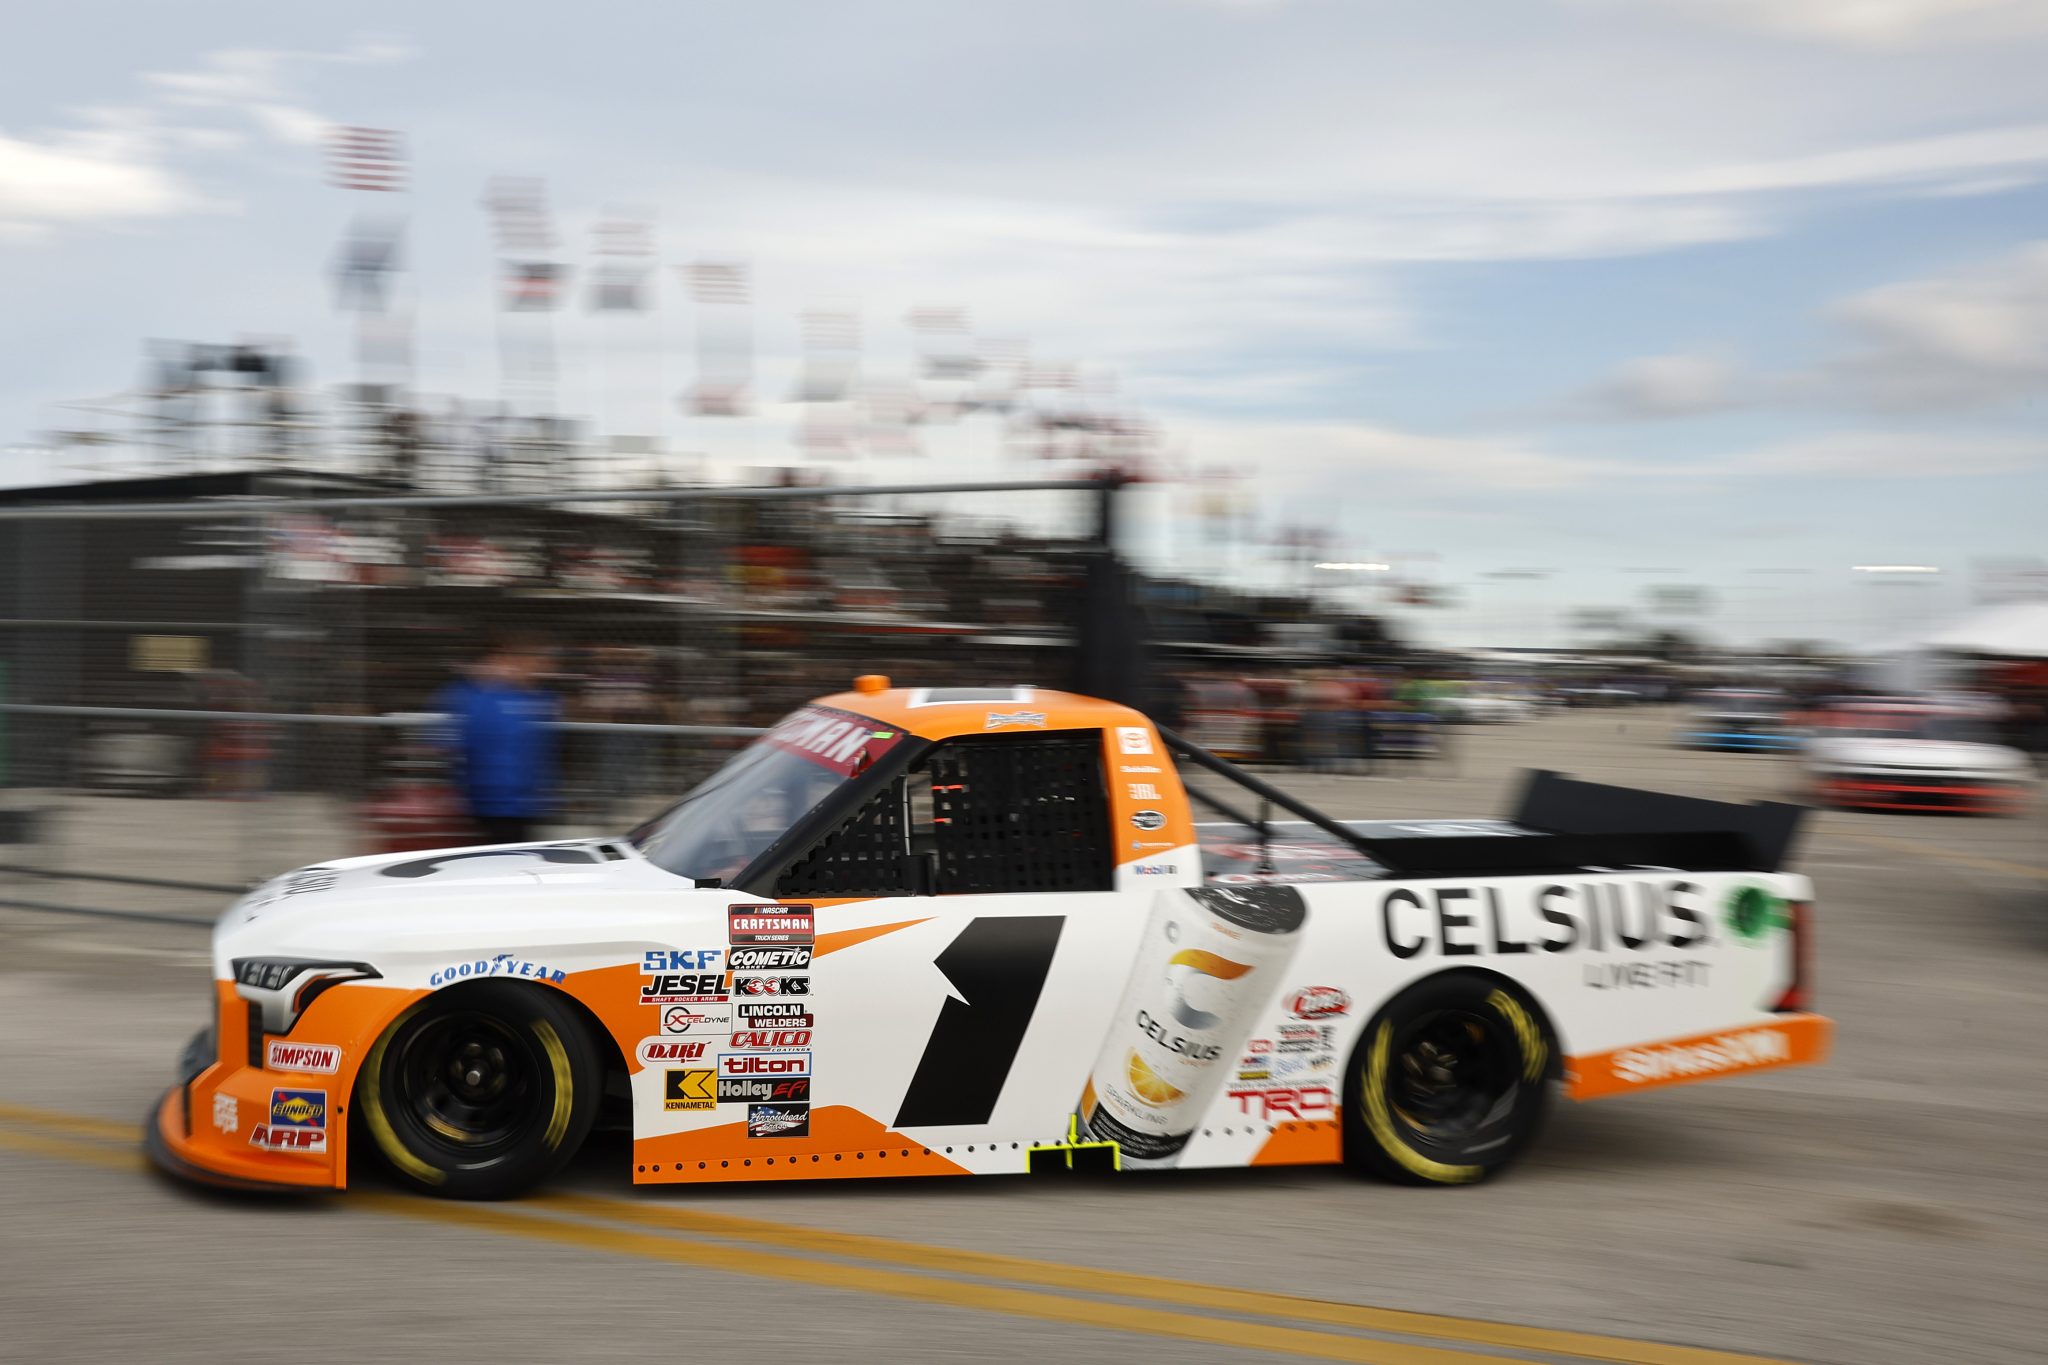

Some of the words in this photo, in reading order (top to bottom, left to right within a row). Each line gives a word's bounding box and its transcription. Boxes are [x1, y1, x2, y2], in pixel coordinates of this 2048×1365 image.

[733, 918, 809, 930] CRAFTSMAN
[1383, 880, 1710, 959] CELSIUS
[644, 951, 721, 970] SKF
[730, 951, 811, 966] COMETIC
[430, 957, 567, 986] GOODYEAR
[643, 975, 730, 995] JESEL
[734, 976, 810, 996] KOOKS
[741, 1005, 801, 1016] LINCOLN
[754, 1018, 807, 1028] WELDERS
[892, 915, 1067, 1128] 1
[730, 1030, 812, 1048] CALICO
[1136, 1009, 1223, 1061] CELSIUS
[272, 1047, 333, 1068] SIMPSON
[724, 1057, 804, 1073] tilton
[718, 1081, 772, 1101] Holley
[272, 1103, 323, 1118] SUNOCO
[1226, 1087, 1332, 1121] TRD
[748, 1109, 809, 1122] Arrowhead
[251, 1126, 325, 1147] ARP
